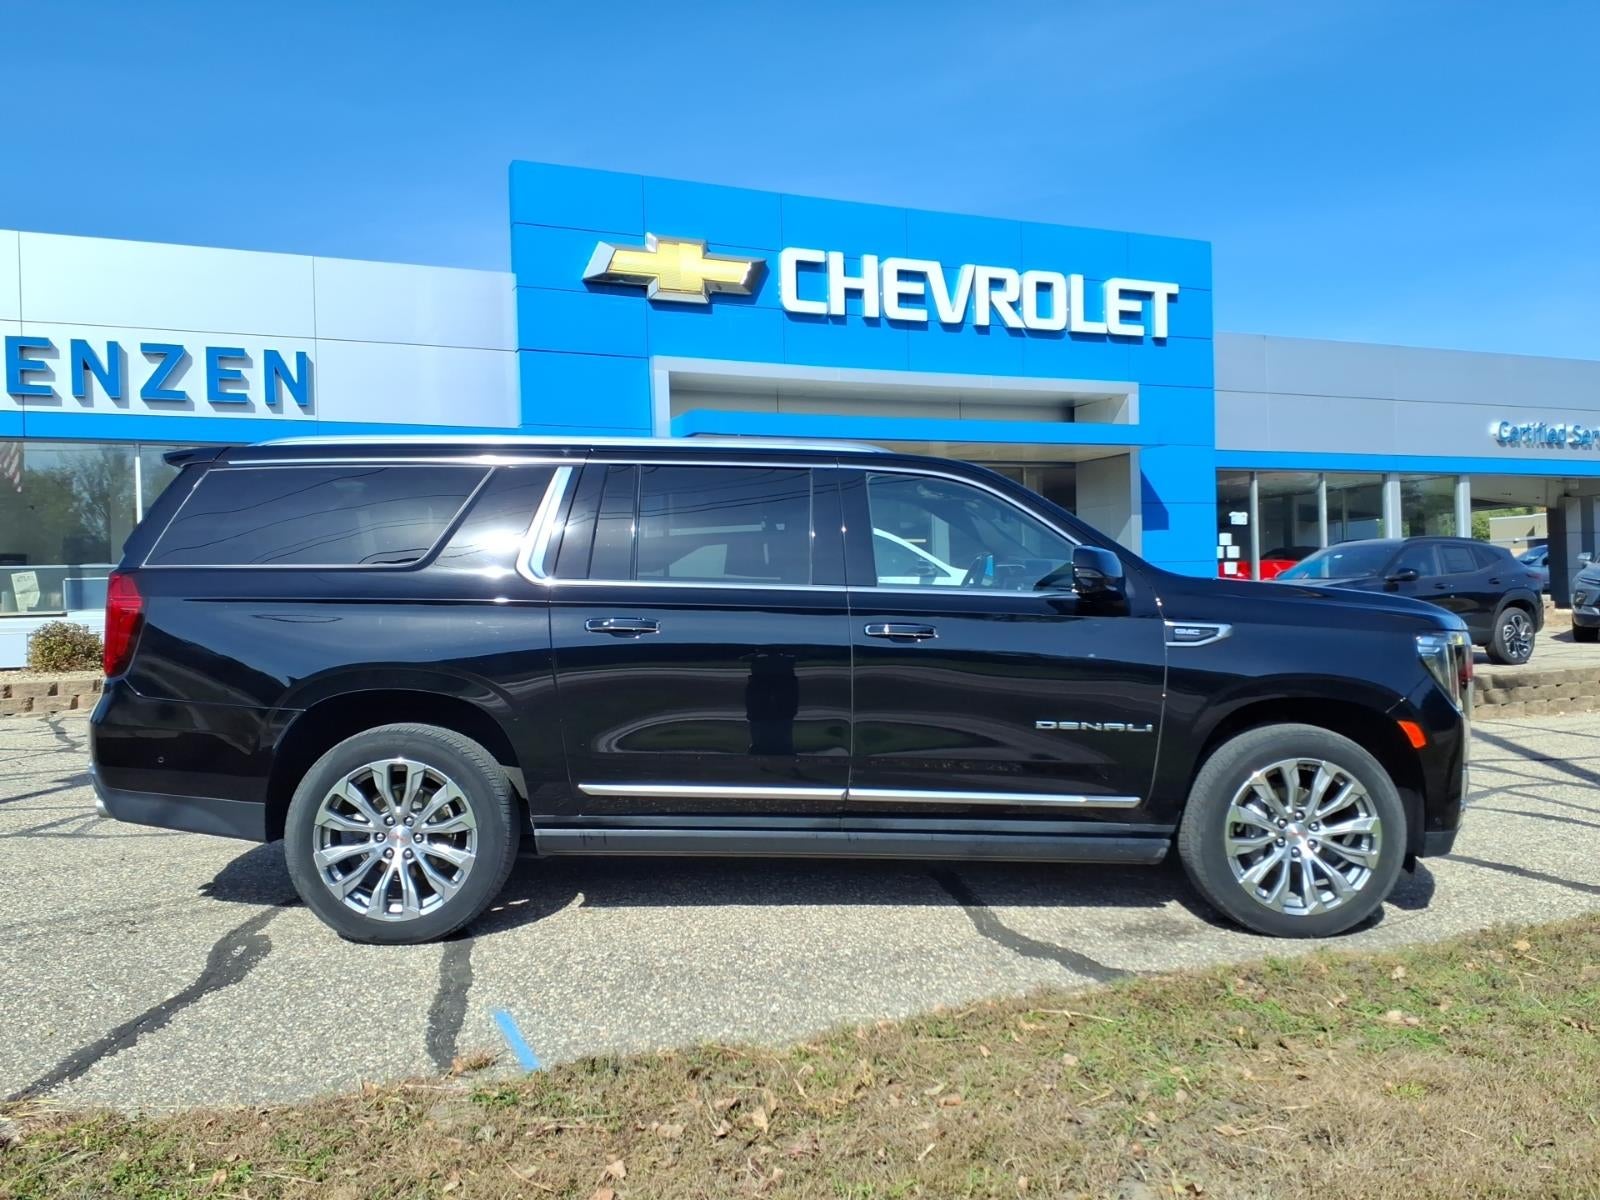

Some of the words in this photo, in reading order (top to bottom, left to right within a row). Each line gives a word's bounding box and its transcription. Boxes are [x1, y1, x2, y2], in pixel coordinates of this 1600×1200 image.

[778, 246, 1180, 339] CHEVROLET
[4, 335, 311, 408] ENZEN
[1498, 420, 1567, 444] Certified
[1035, 720, 1153, 732] DENALI
